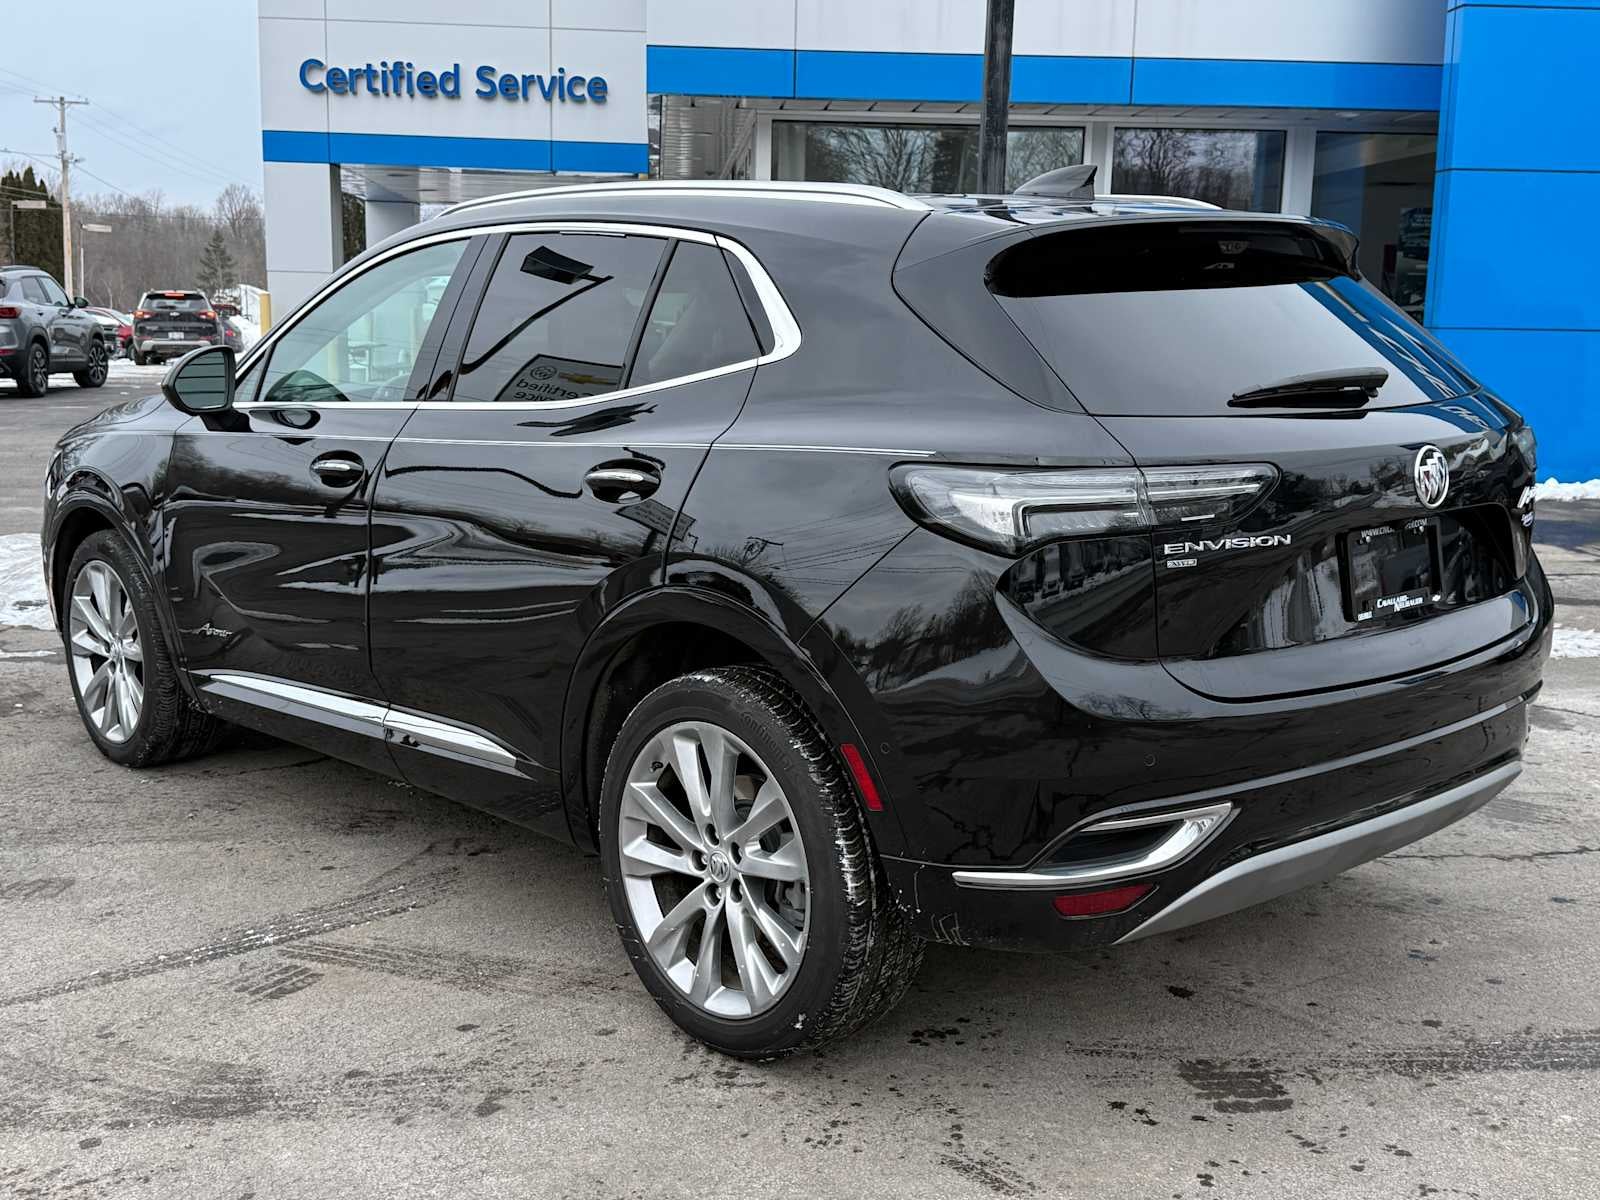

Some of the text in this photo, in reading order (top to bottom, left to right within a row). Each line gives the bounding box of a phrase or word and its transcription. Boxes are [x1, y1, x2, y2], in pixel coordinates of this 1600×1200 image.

[299, 58, 609, 102] Certified Service
[1163, 534, 1292, 555] ENVISION
